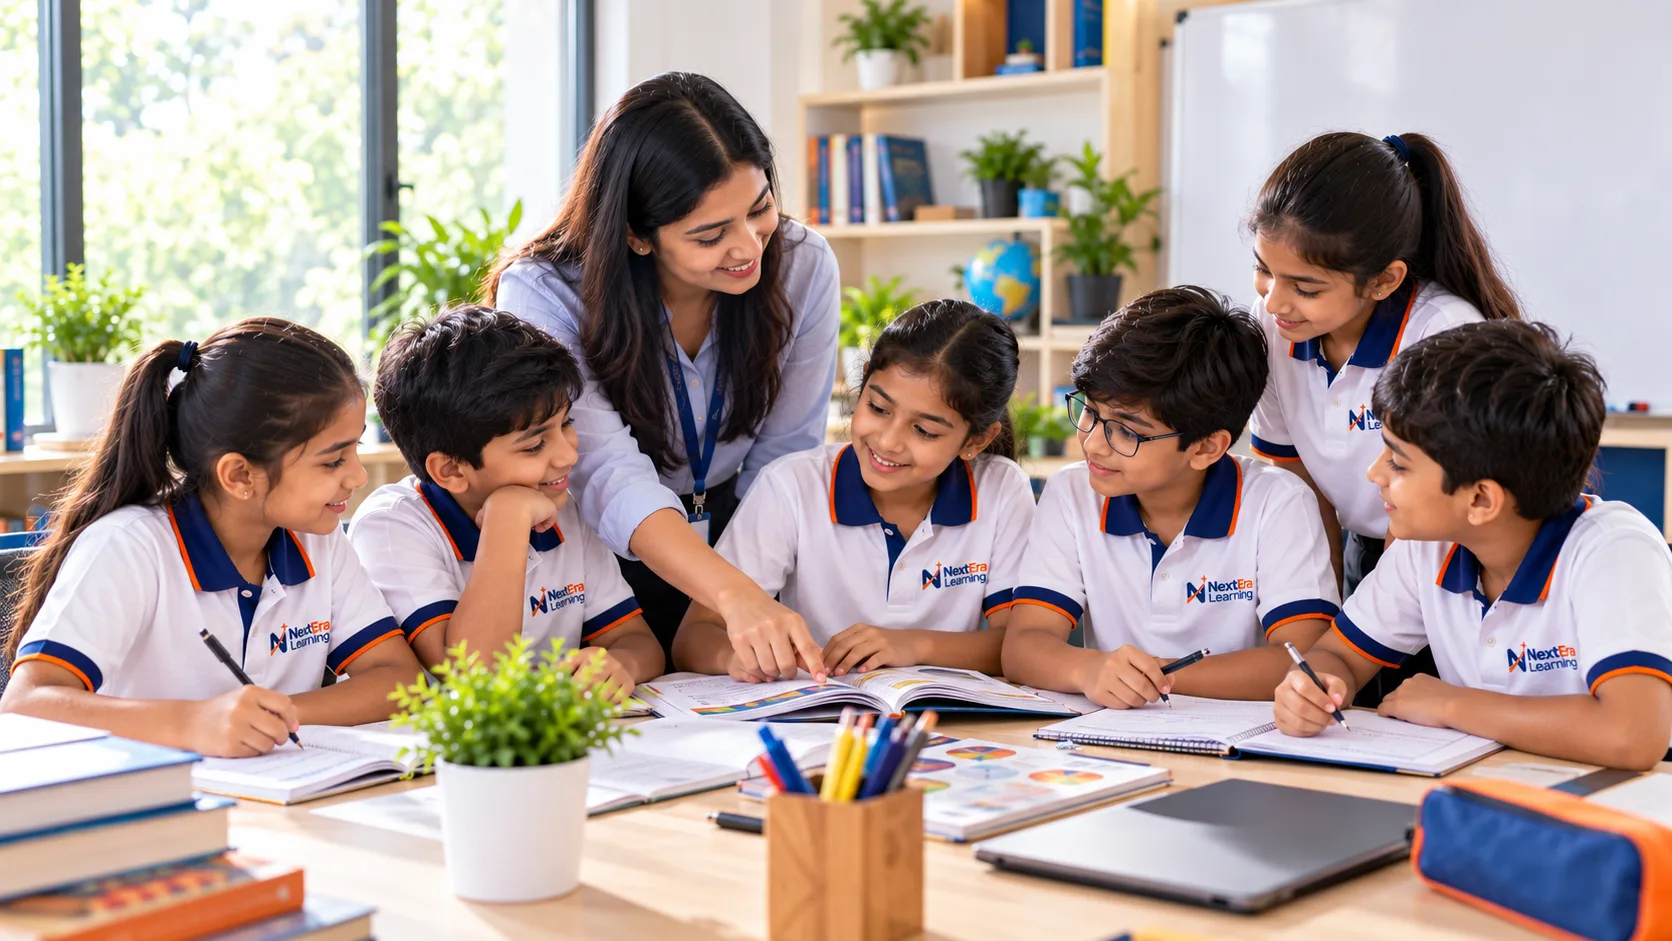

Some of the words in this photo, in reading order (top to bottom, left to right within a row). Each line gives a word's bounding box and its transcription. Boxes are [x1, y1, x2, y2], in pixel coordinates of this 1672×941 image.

[943, 562, 988, 577] NextEra
[944, 573, 987, 587] Learning
[1208, 578, 1253, 592] NextEra
[547, 583, 585, 601] NextEra
[1209, 590, 1253, 603] Learning
[550, 594, 585, 611] Learning
[288, 621, 331, 640] NextEra
[290, 632, 330, 650] Learning
[1527, 645, 1576, 661] NextEra
[1529, 658, 1578, 673] Learning
